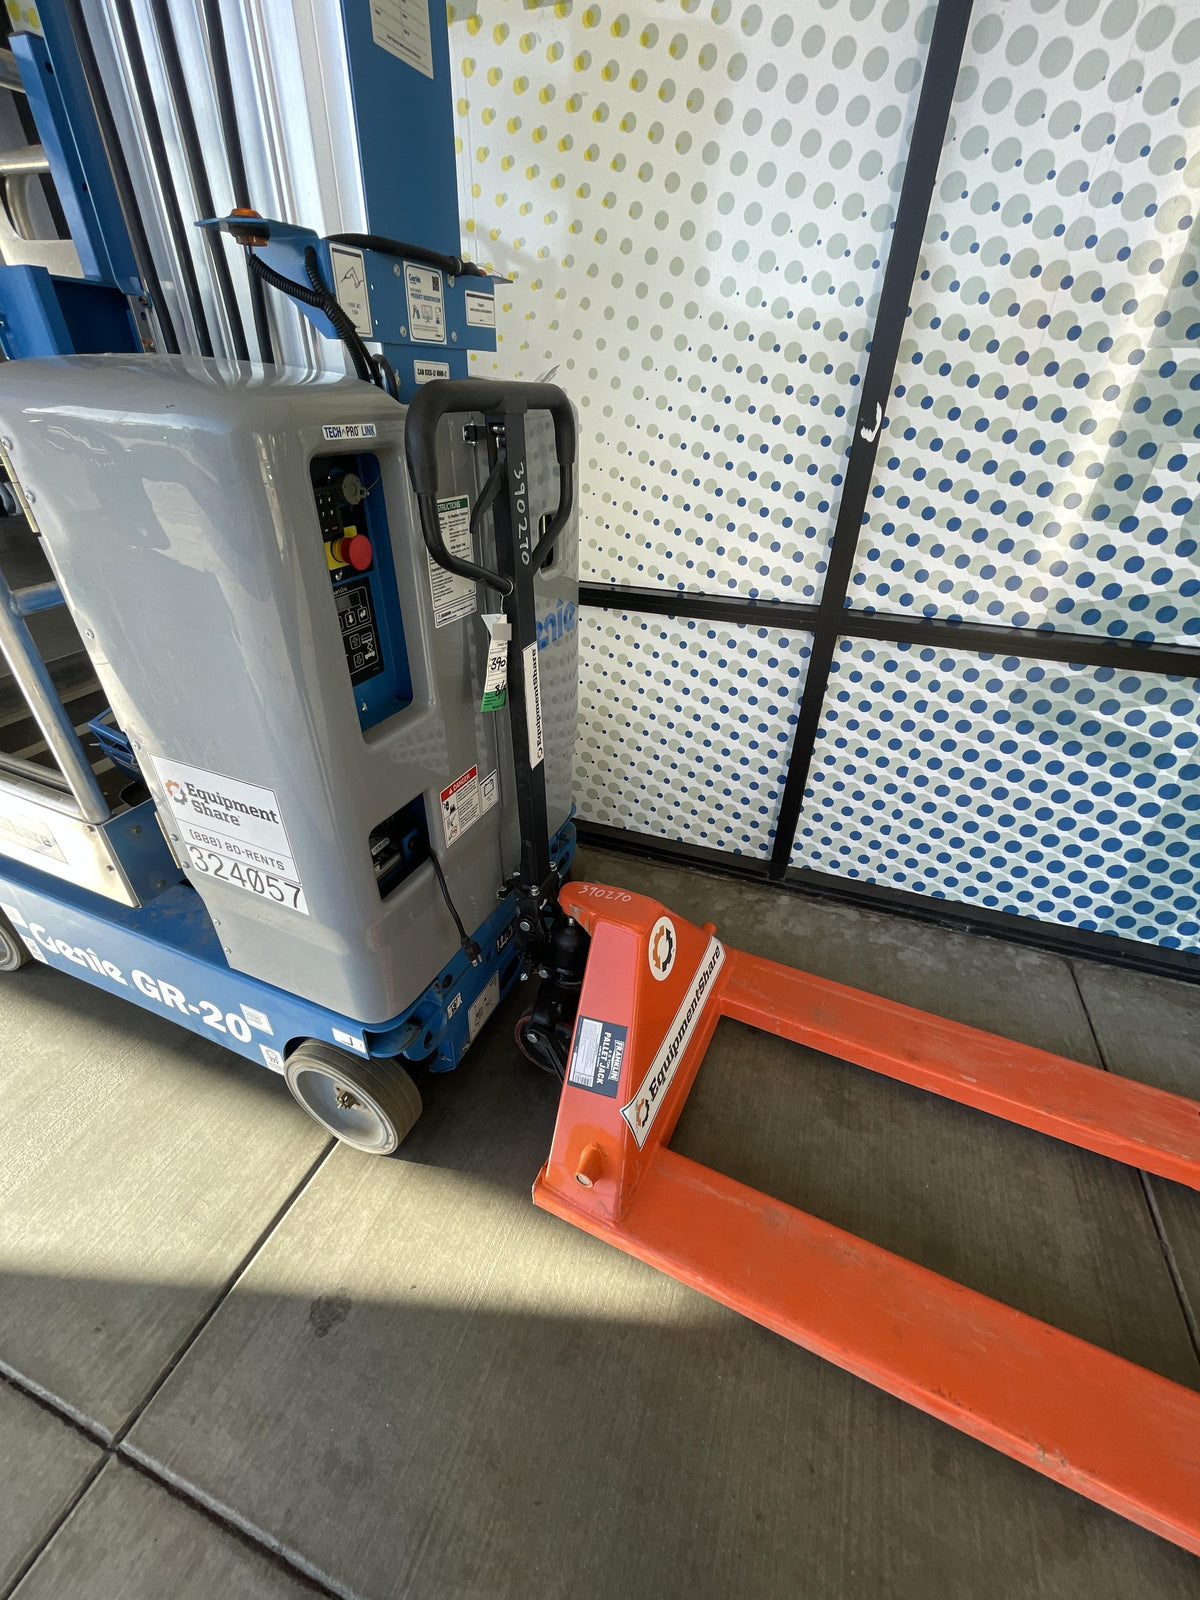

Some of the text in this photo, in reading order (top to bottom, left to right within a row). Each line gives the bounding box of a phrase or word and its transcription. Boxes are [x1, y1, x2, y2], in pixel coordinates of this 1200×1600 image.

[324, 426, 342, 438] TECH
[361, 425, 375, 436] LINK
[536, 597, 576, 651] enie
[532, 649, 543, 747] EquipmentShare
[184, 781, 279, 824] Equipment
[452, 774, 471, 791] DANGER
[191, 799, 241, 827] Share
[189, 828, 285, 871] (888) 80-RENTS
[189, 845, 301, 909] 324057
[29, 922, 252, 1044] Genie GR-20
[648, 945, 720, 1102] EquipmentShare
[600, 1031, 612, 1061] PALLET
[609, 1040, 624, 1081] FRANKLIN
[596, 1062, 606, 1085] JACK
